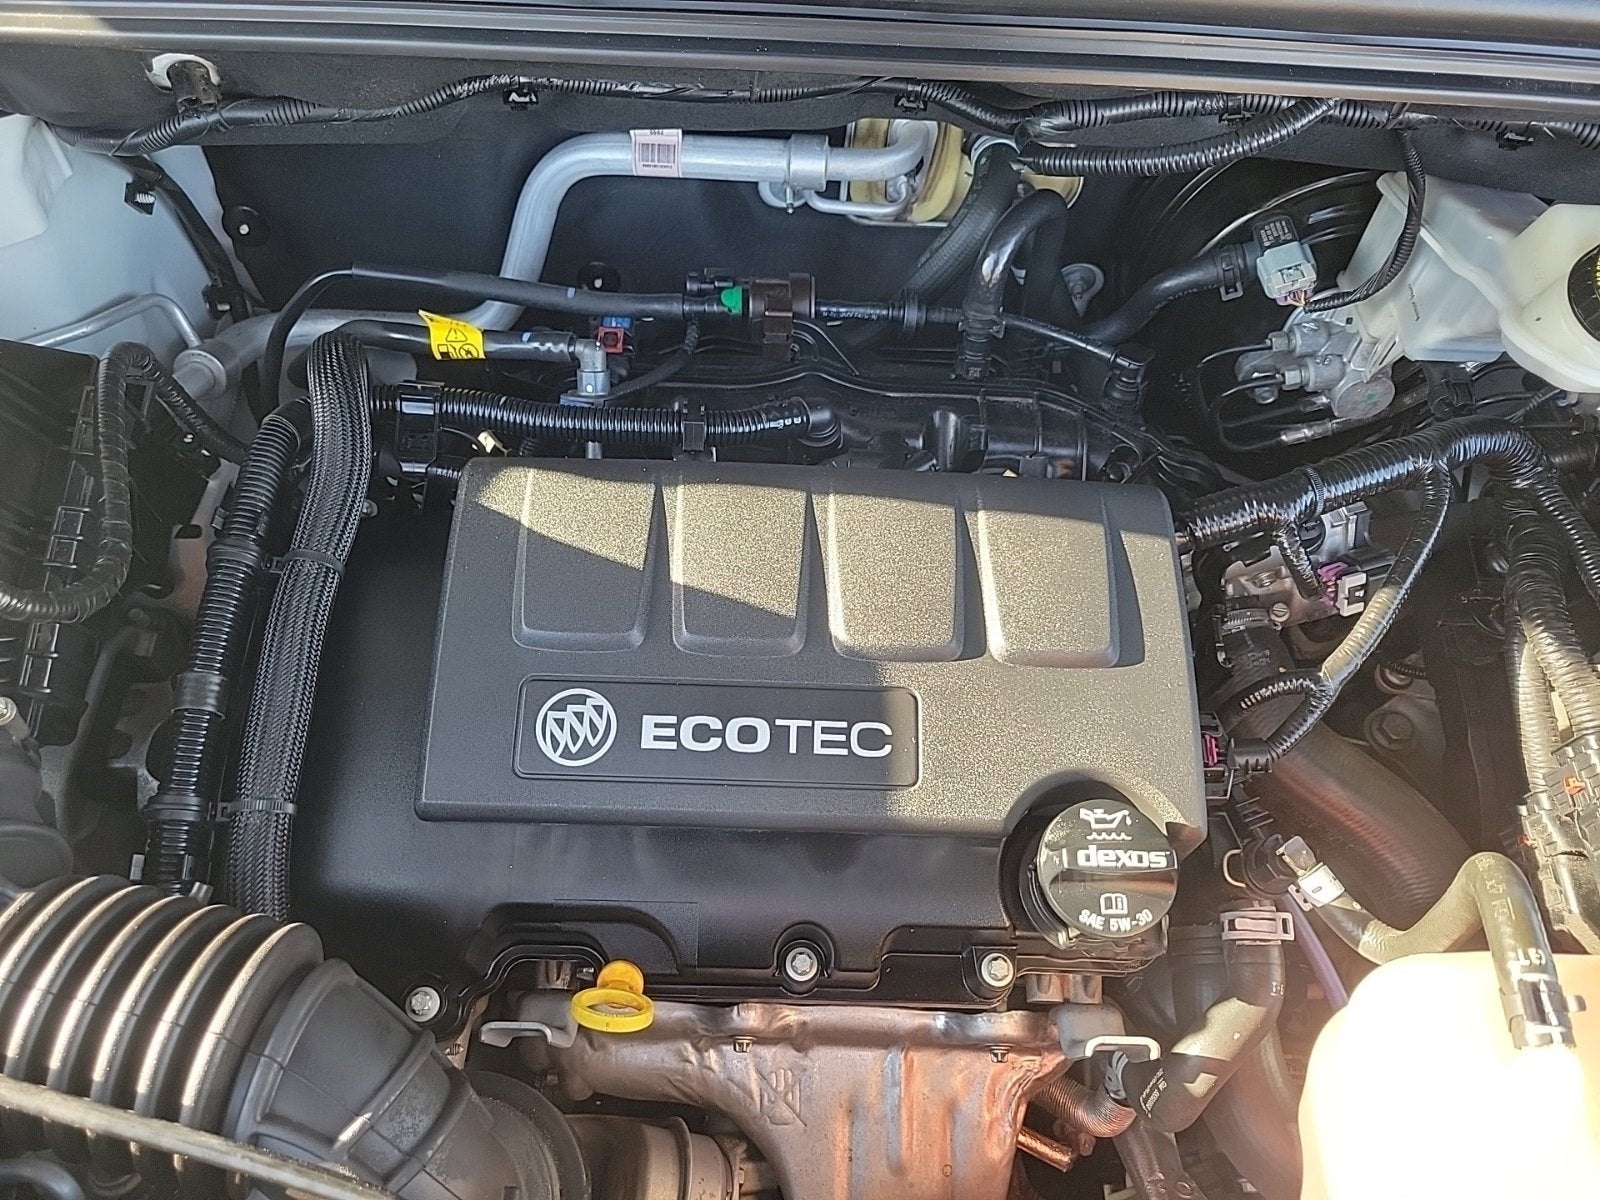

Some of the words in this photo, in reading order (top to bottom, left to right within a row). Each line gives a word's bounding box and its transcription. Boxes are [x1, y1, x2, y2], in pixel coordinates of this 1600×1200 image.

[640, 714, 893, 758] ECOTEC
[1077, 844, 1168, 869] dexos
[1078, 908, 1105, 931] SAE
[1109, 908, 1153, 932] 5W-30
